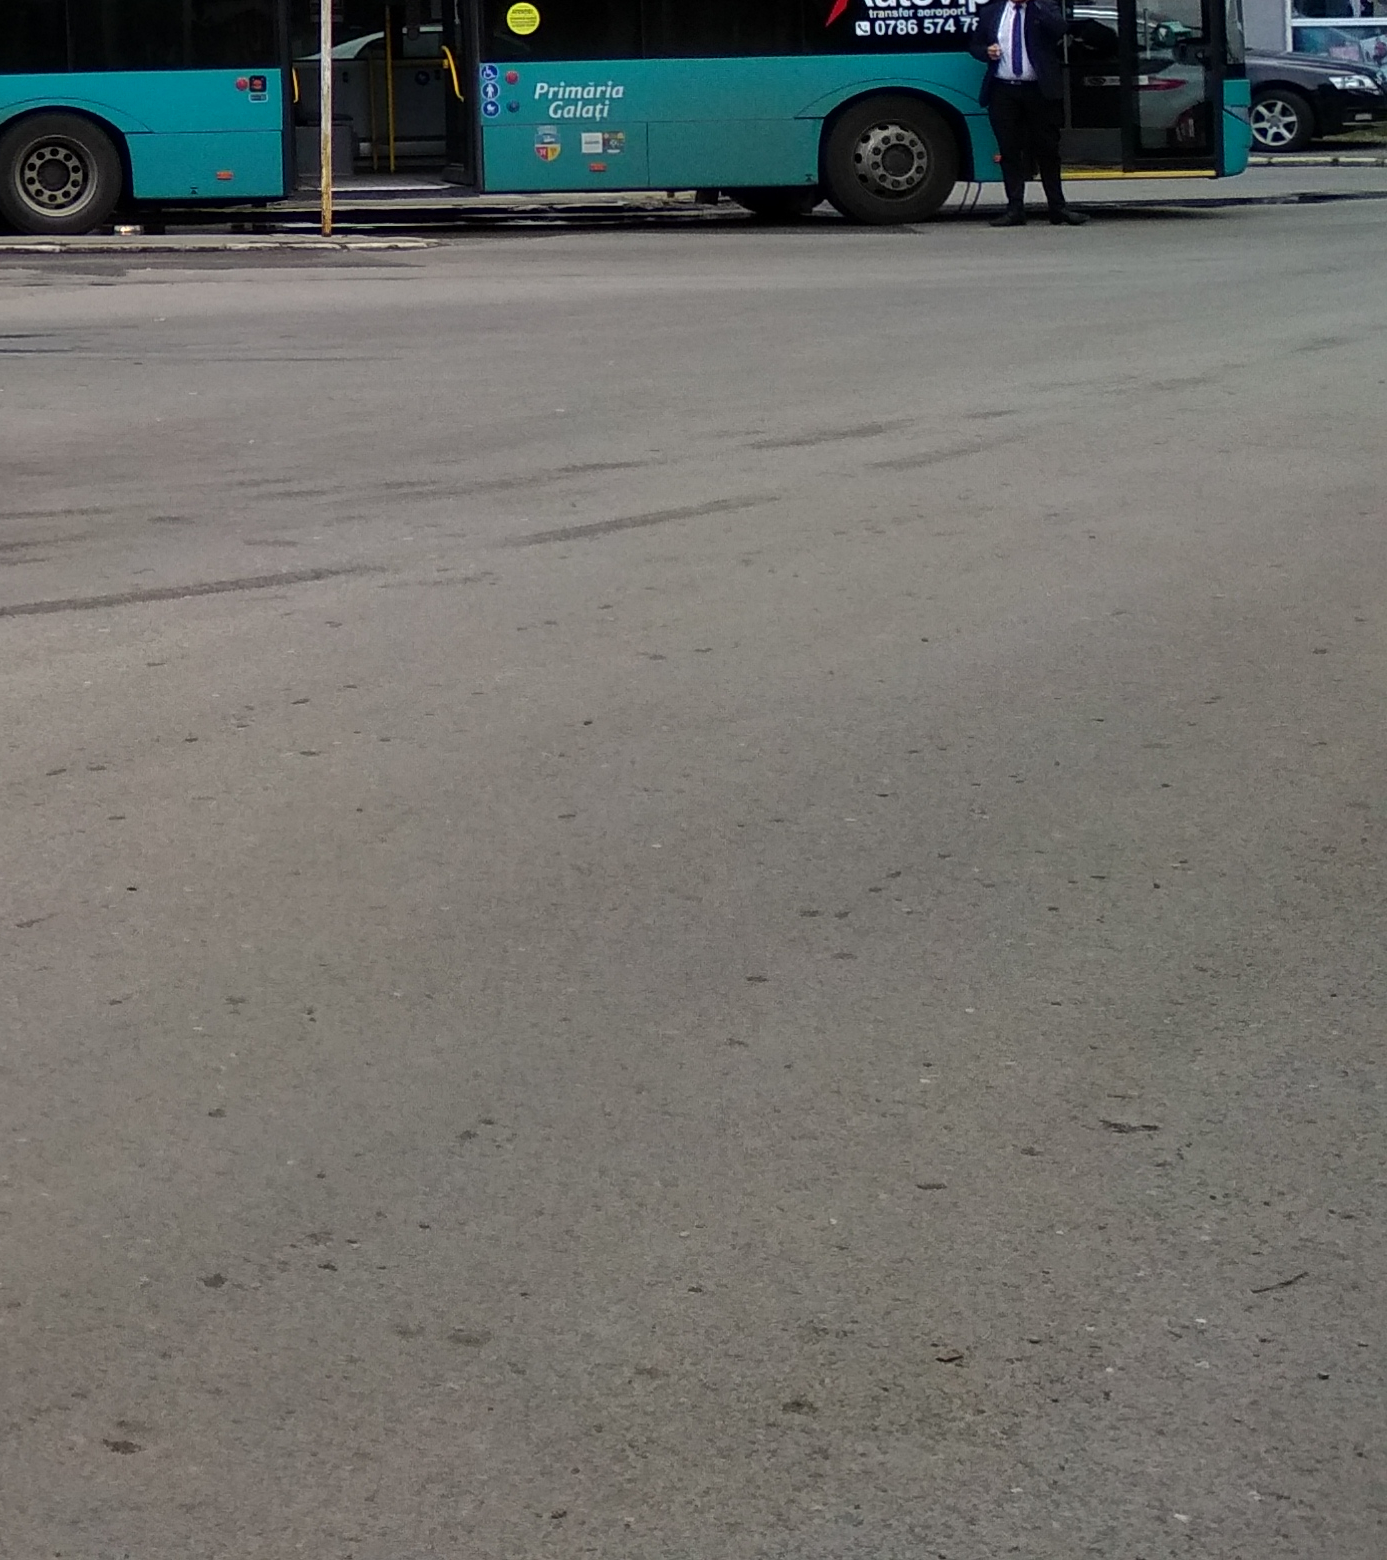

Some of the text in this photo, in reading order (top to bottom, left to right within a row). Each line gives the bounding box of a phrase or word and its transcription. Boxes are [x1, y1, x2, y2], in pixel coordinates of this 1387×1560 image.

[868, 6, 967, 19] transfer aeroport
[874, 20, 919, 36] 0786
[923, 17, 957, 35] 574
[534, 80, 625, 100] Primăria
[548, 99, 610, 122] Galați
